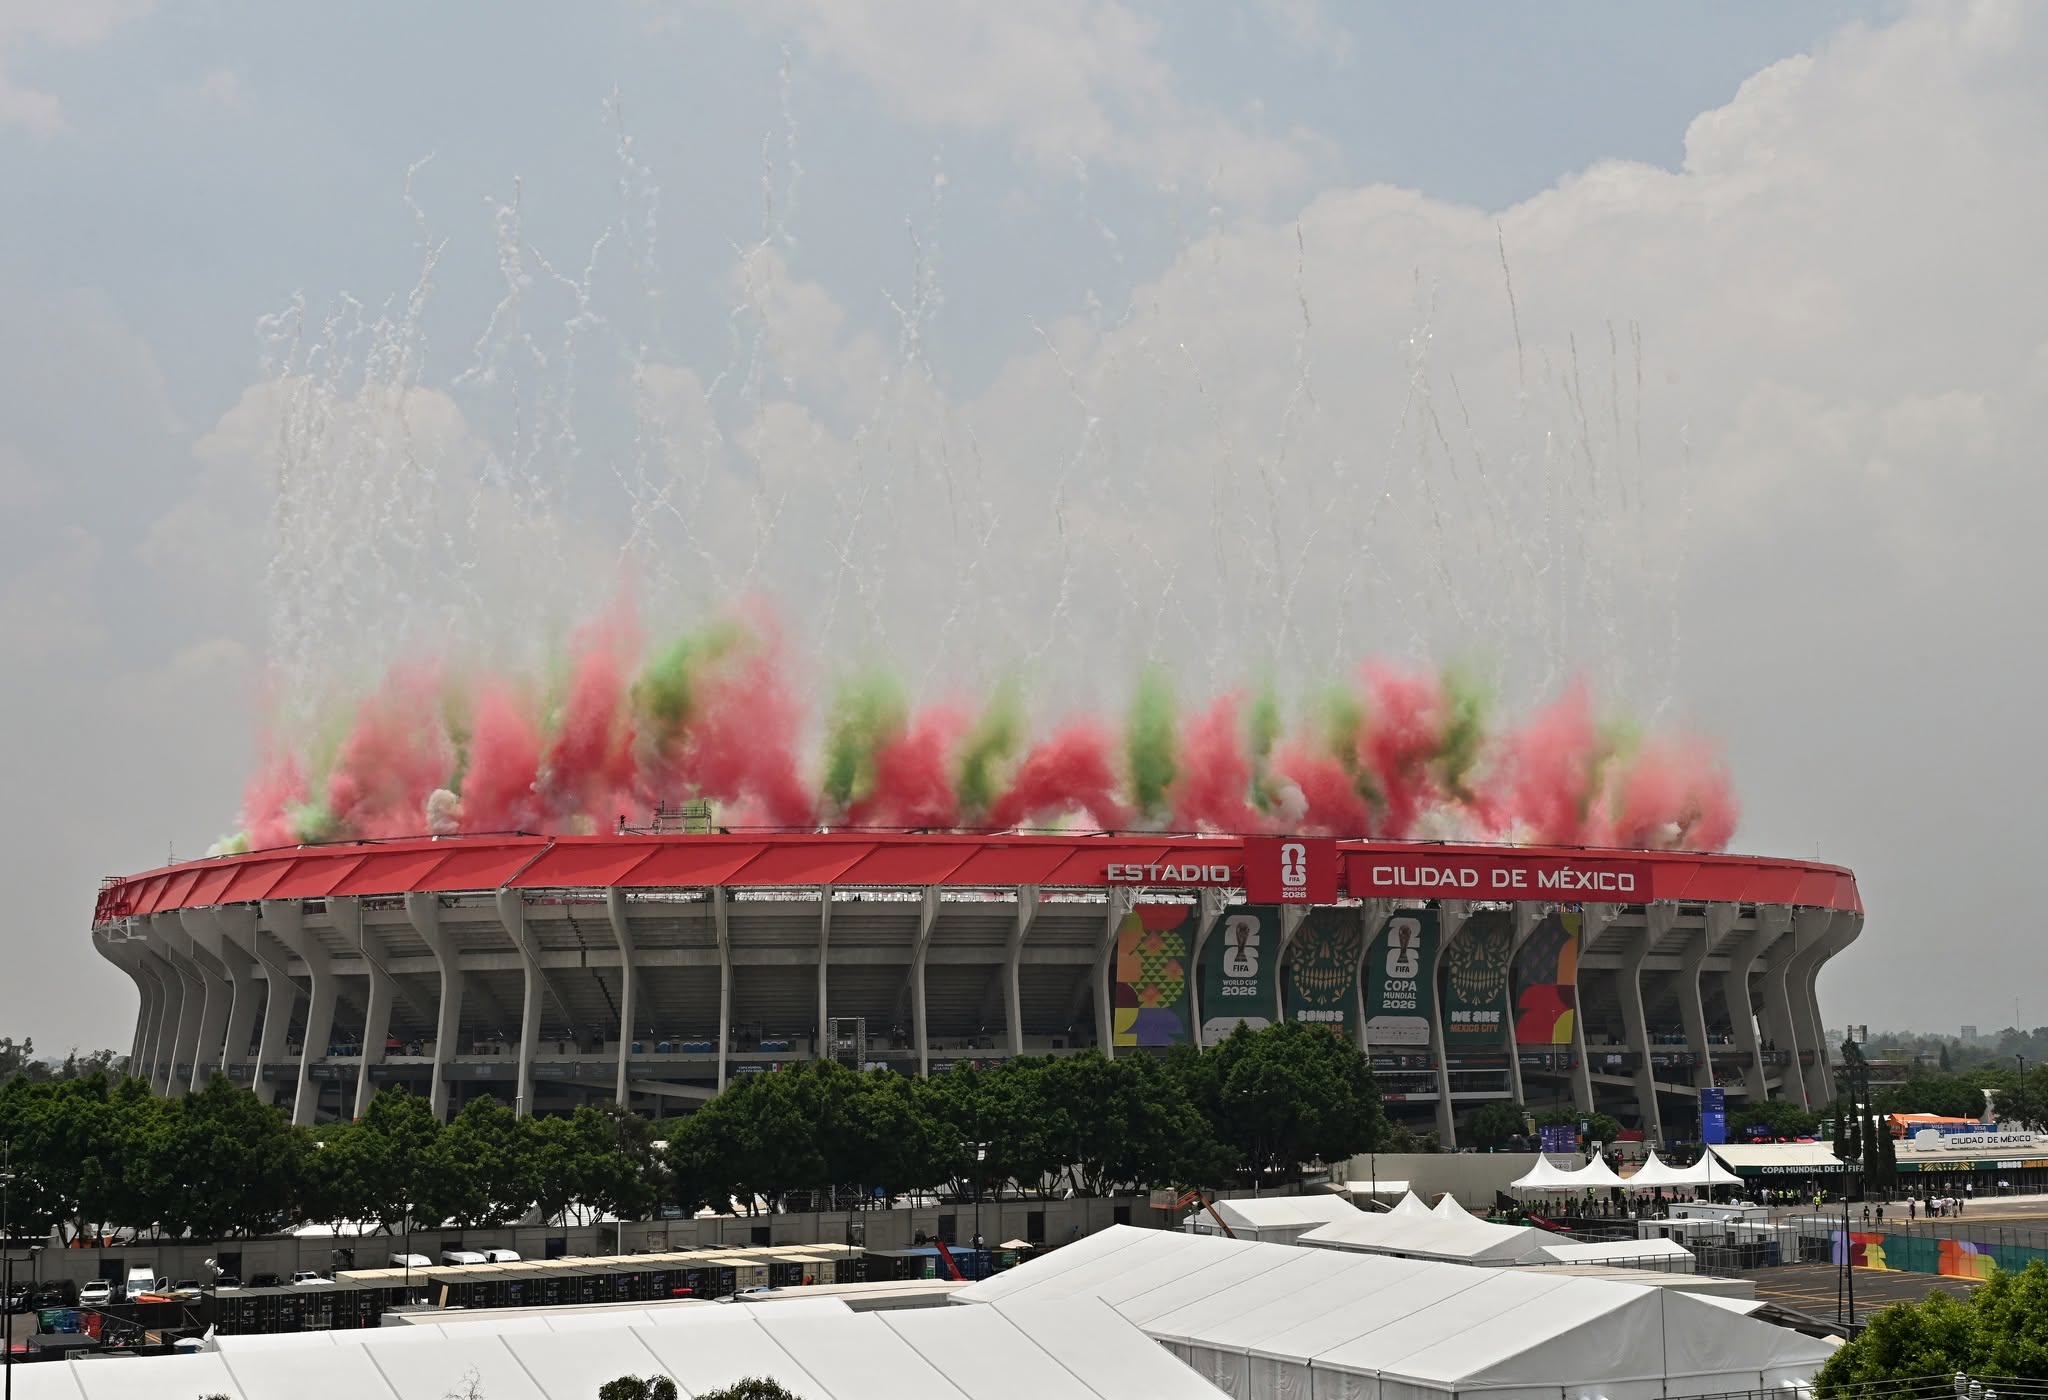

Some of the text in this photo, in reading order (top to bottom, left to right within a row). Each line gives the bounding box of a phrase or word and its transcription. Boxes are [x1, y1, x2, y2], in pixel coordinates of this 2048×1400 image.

[1107, 863, 1230, 882] ESTADIO
[1372, 866, 1635, 892] CIUDAD DE MÉXICO
[1232, 964, 1249, 972] FIFA
[1395, 965, 1410, 973] FIFA
[1221, 986, 1257, 996] 2026
[1384, 980, 1417, 992] COPA
[1383, 991, 1417, 1000] MUNDIAL
[1382, 999, 1417, 1009] 2026
[1297, 1010, 1344, 1022] SOMOS
[1451, 1010, 1500, 1022] WE ARE
[1481, 1024, 1499, 1032] CITY
[1951, 1134, 2031, 1145] CIUDAD DE MÉXICO
[1761, 1166, 1785, 1174] COPA
[1785, 1164, 1823, 1173] MUNDIAL
[1824, 1165, 1835, 1173] DE
